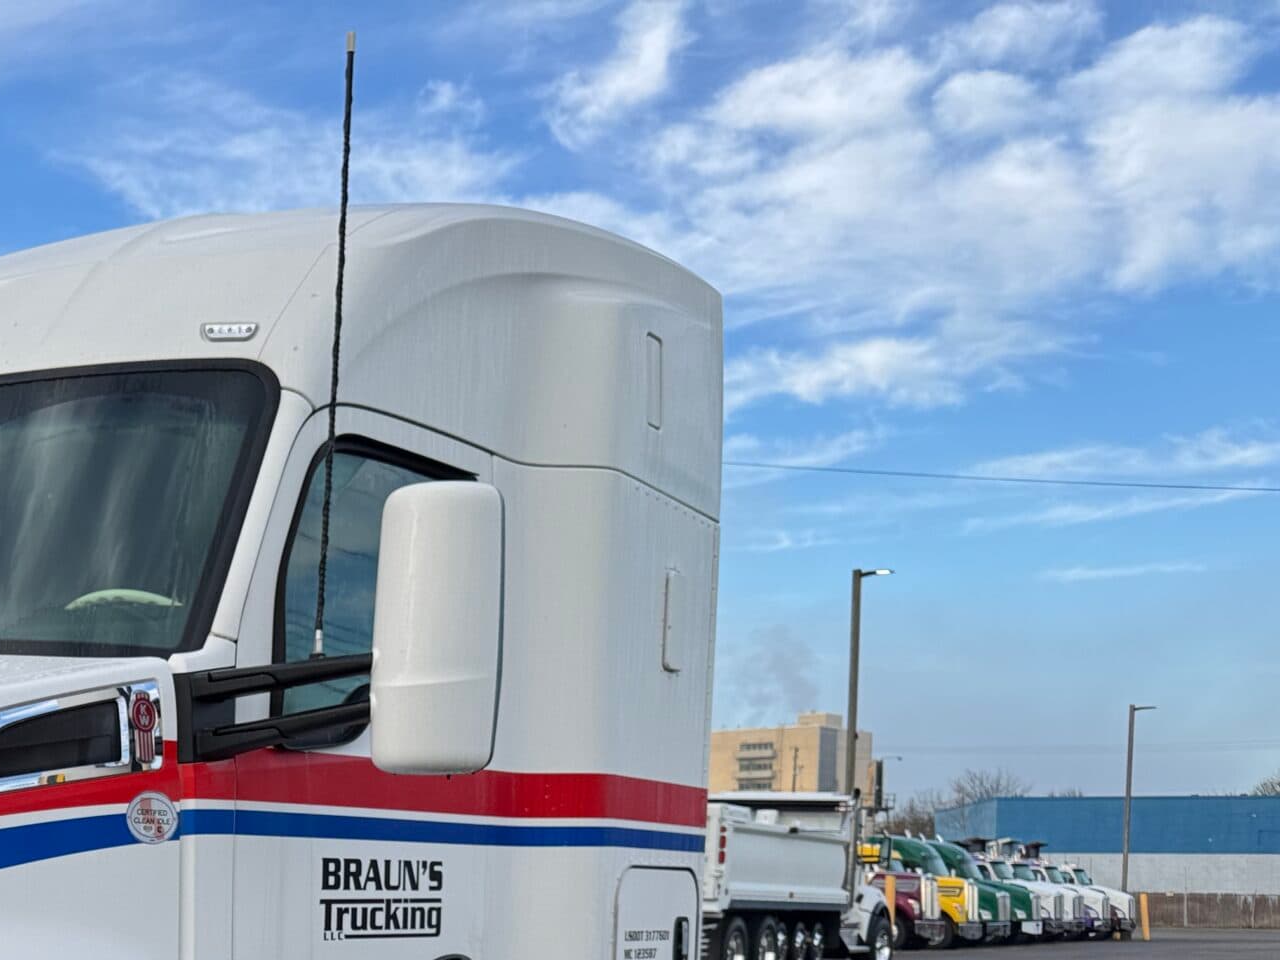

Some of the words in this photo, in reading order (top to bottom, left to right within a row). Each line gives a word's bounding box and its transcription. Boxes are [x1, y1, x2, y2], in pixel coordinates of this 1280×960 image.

[136, 808, 168, 817] CERTIFIED
[133, 816, 155, 825] CLEAN
[321, 857, 443, 891] BRAUN'S
[320, 898, 442, 939] Trucking
[323, 931, 344, 941] LLC
